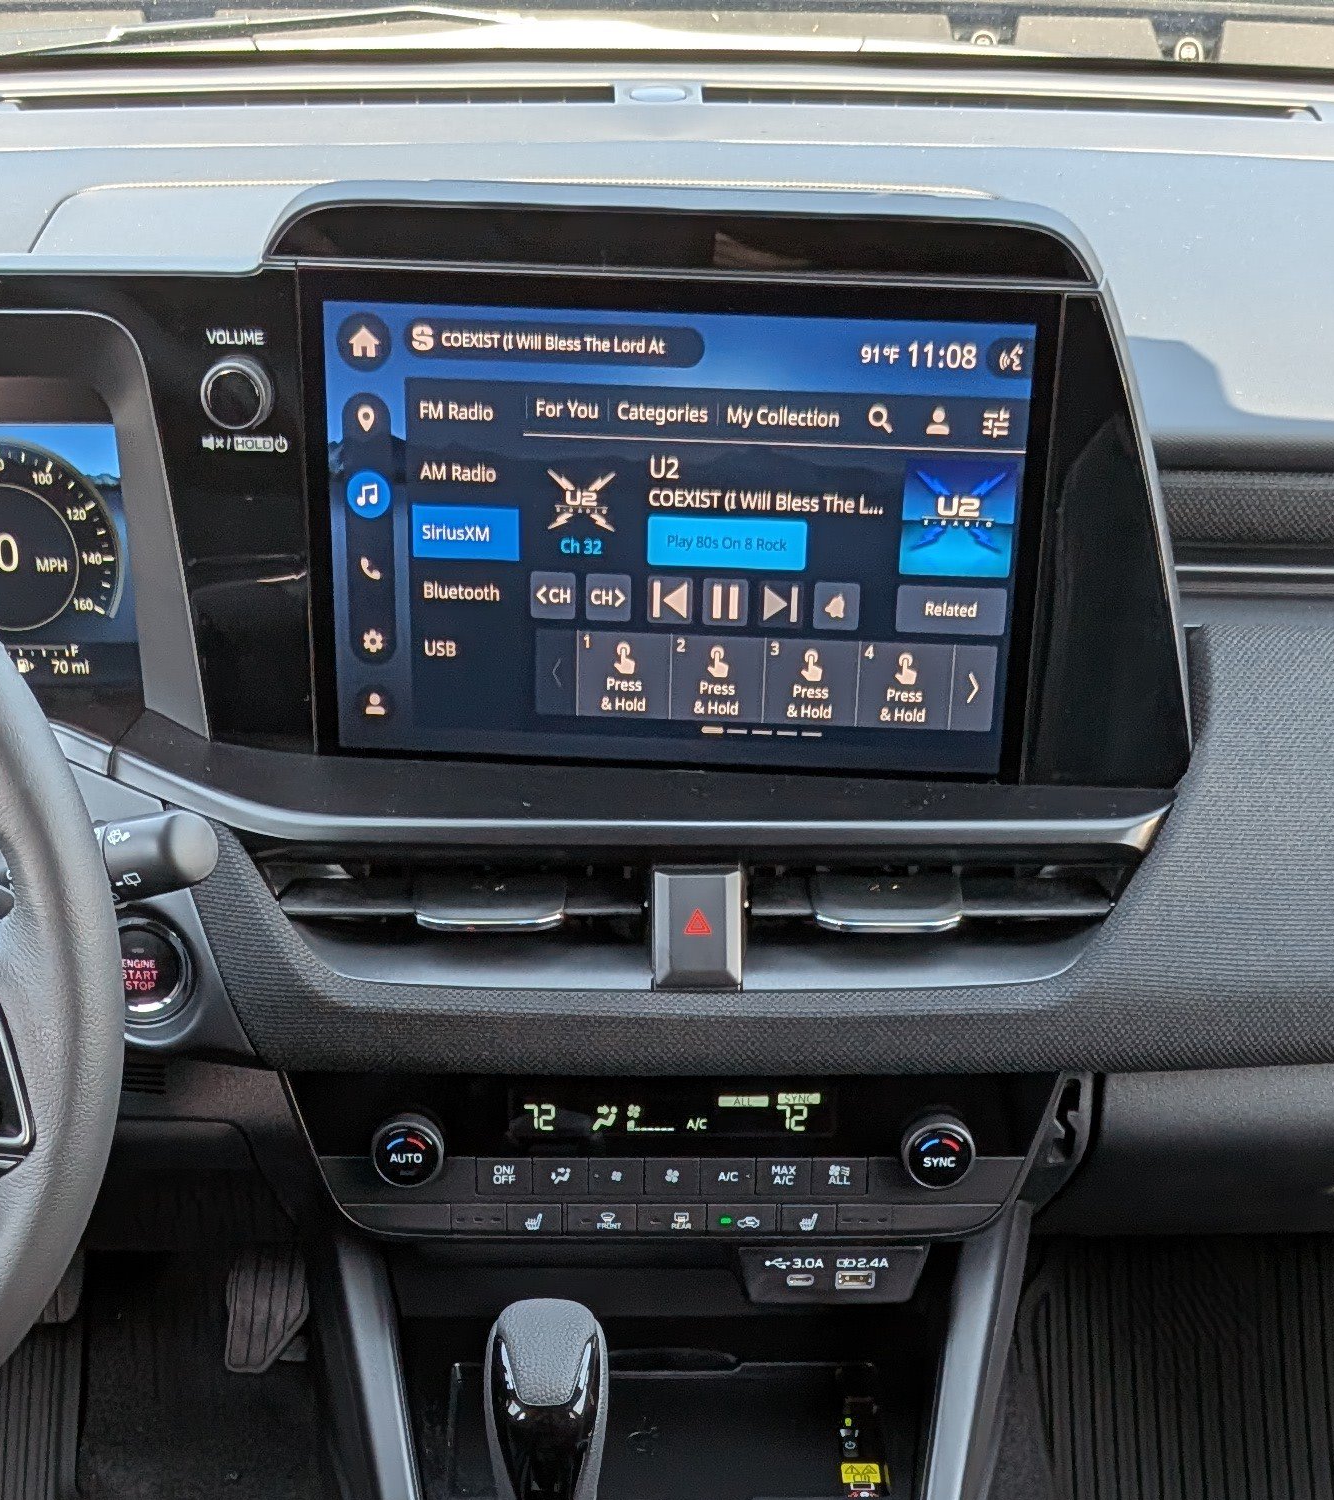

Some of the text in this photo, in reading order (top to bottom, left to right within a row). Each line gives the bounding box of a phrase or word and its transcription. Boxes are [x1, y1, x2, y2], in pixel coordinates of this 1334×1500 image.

[206, 328, 265, 345] VOLUME
[441, 332, 500, 349] COEXIST
[516, 334, 542, 351] Will
[545, 335, 581, 352] Bless
[583, 337, 610, 353] The
[613, 337, 646, 354] Lord
[648, 338, 666, 354] At
[908, 341, 978, 370] 11:08
[419, 400, 494, 422] FM Radio
[536, 399, 599, 419] For You
[617, 401, 708, 427] Categories
[727, 405, 840, 429] My Collection
[234, 437, 273, 451] HOLD
[420, 462, 497, 483] AM Radio
[649, 455, 680, 480] U2
[32, 471, 53, 485] 100
[565, 488, 598, 507] U2
[649, 489, 721, 510] COEXIST
[740, 491, 770, 511] Will
[776, 492, 819, 513] Bless
[822, 493, 855, 514] The
[67, 507, 87, 521] 120
[937, 494, 981, 518] U2
[421, 524, 490, 543] SiriusXM
[560, 536, 603, 556] Ch 32
[666, 534, 788, 552] Play 80s On 8 Rock
[35, 556, 69, 573] MPH
[82, 550, 103, 566] 140
[422, 580, 501, 602] Bluetooth
[73, 597, 94, 611] 160
[924, 600, 978, 619] Related
[424, 638, 457, 658] USB
[583, 633, 592, 649] 1
[676, 637, 687, 653] 2
[770, 640, 781, 656] 3
[70, 644, 80, 658] F
[863, 644, 876, 660] 4
[51, 660, 69, 675] 70
[606, 676, 642, 692] Press
[699, 681, 736, 697] Press
[792, 684, 829, 701] Press
[886, 687, 923, 704] Press
[601, 697, 646, 713] & Hold
[693, 700, 739, 716] & Hold
[787, 704, 832, 720] & Hold
[879, 707, 926, 724] & Hold
[121, 958, 156, 969] ENGINE
[121, 970, 159, 981] START
[125, 981, 156, 991] STOP
[733, 1096, 754, 1107] ALL
[783, 1093, 814, 1105] SYNC
[523, 1103, 556, 1132] 72
[686, 1117, 708, 1131] A/C
[776, 1105, 809, 1132] 72
[389, 1153, 423, 1164] AUTO
[923, 1156, 957, 1169] SYNC
[493, 1165, 515, 1176] ON/
[718, 1170, 739, 1182] A/C
[771, 1165, 797, 1177] MAX
[493, 1174, 516, 1185] OFF
[773, 1175, 795, 1186] A/C
[828, 1175, 851, 1186] ALL
[791, 1258, 824, 1269] 3.0A
[856, 1258, 889, 1269] 2.4A
